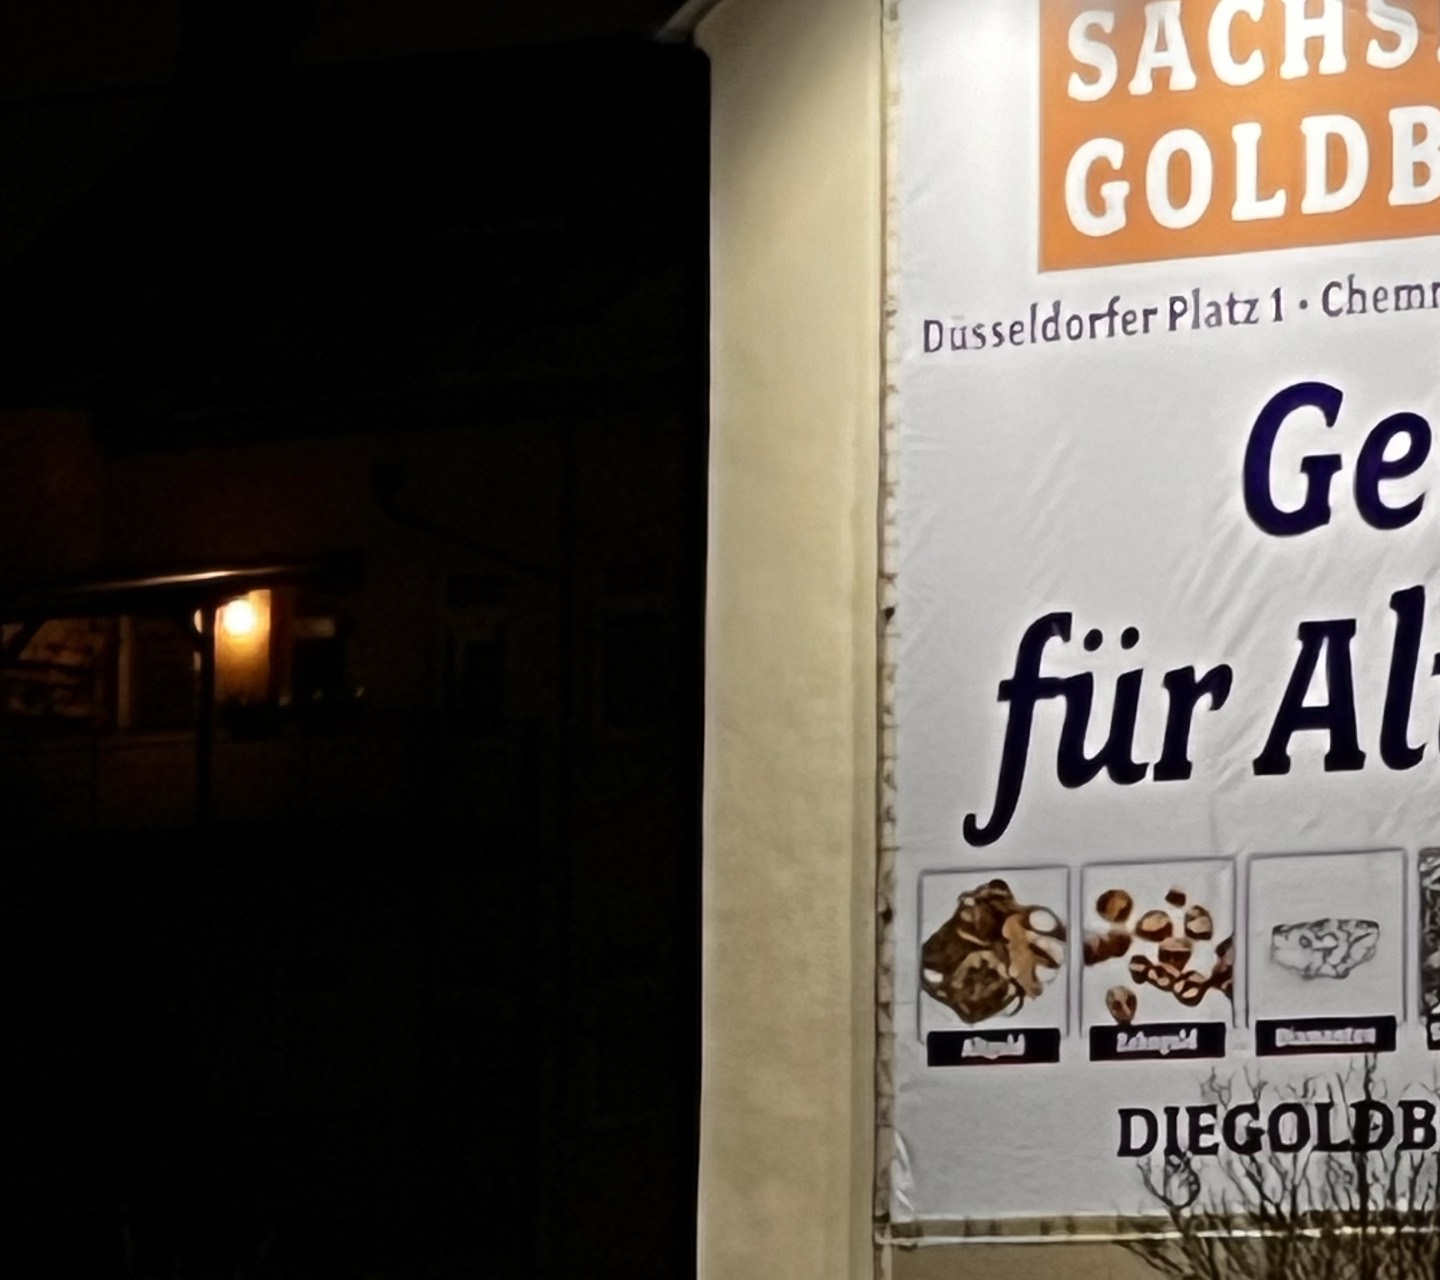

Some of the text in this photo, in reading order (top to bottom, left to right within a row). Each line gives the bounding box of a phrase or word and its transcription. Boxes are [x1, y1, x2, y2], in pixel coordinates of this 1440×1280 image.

[922, 295, 1158, 354] Düsseldorfer
[1167, 286, 1261, 332] Platz
[1271, 286, 1284, 323] 1
[963, 611, 1233, 847] für
